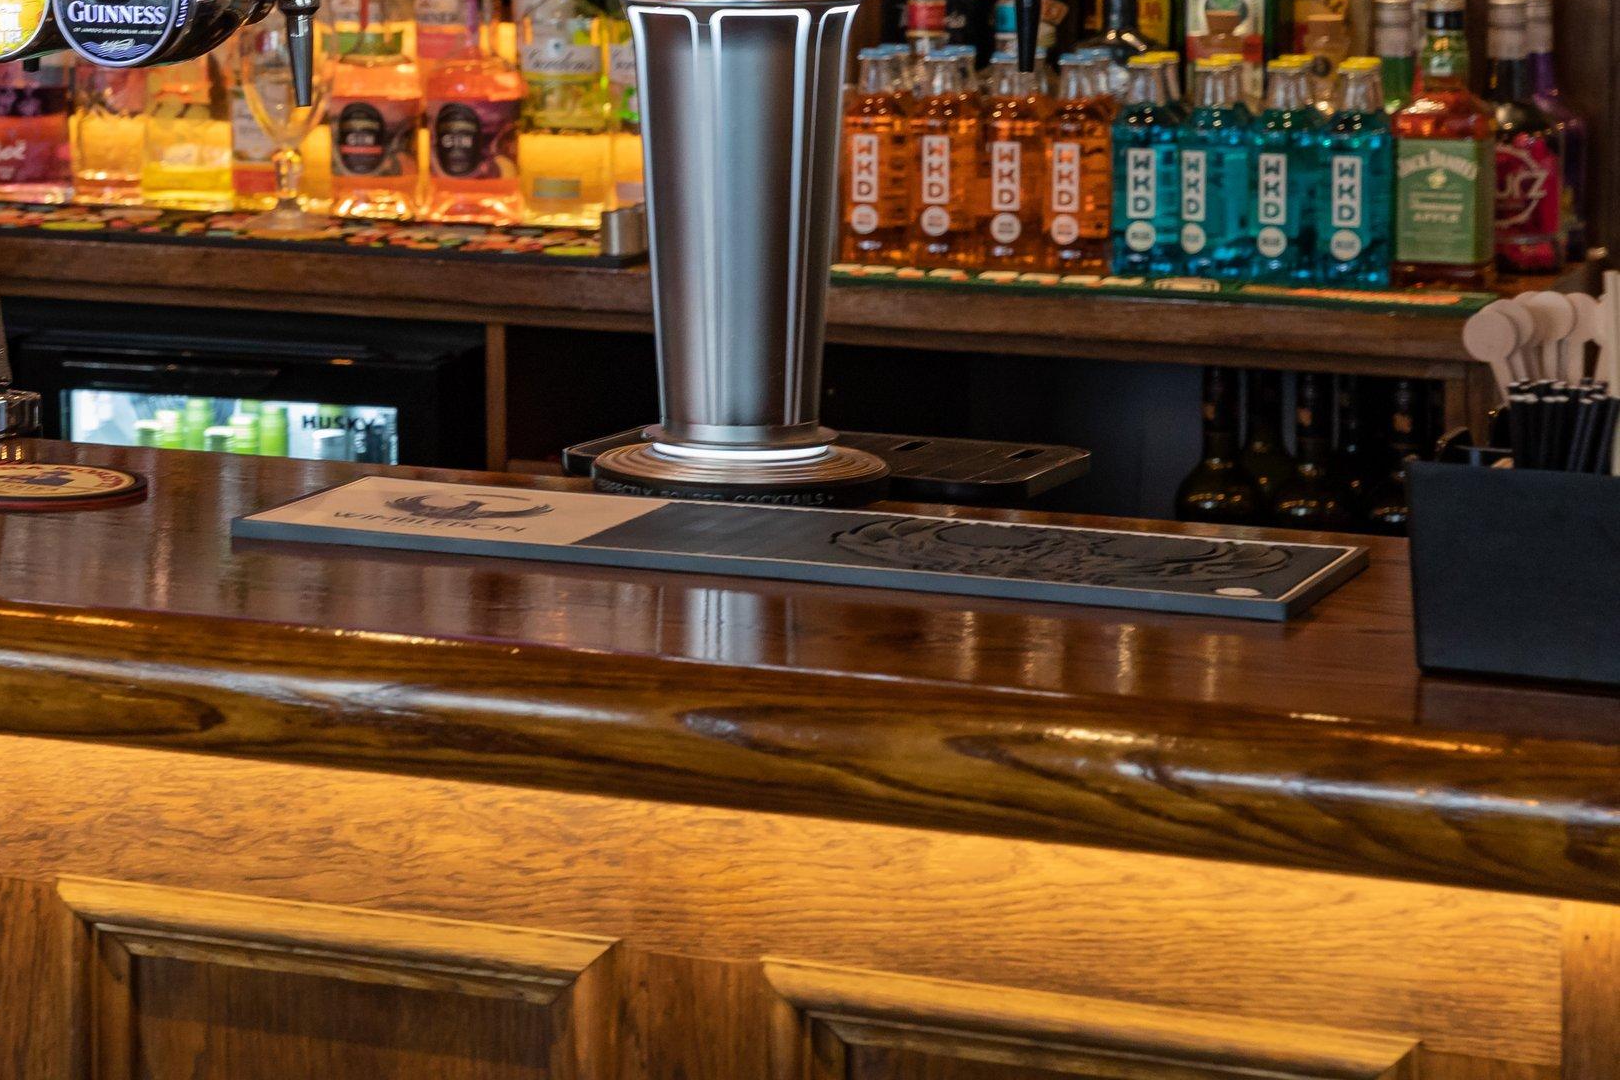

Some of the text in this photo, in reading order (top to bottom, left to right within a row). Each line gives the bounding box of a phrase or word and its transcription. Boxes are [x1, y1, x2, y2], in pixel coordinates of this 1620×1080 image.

[67, 0, 170, 25] GUINNESS
[856, 139, 873, 197] WKD
[926, 139, 945, 198] WKD
[997, 147, 1016, 206] WKD
[1057, 148, 1075, 207] WKD
[1132, 154, 1151, 213] WKD
[1185, 157, 1200, 216] WKD
[1263, 159, 1281, 219] WKD
[1337, 162, 1356, 222] WKD
[301, 415, 376, 431] HUSKY
[333, 510, 528, 533] WIMBLEDON
